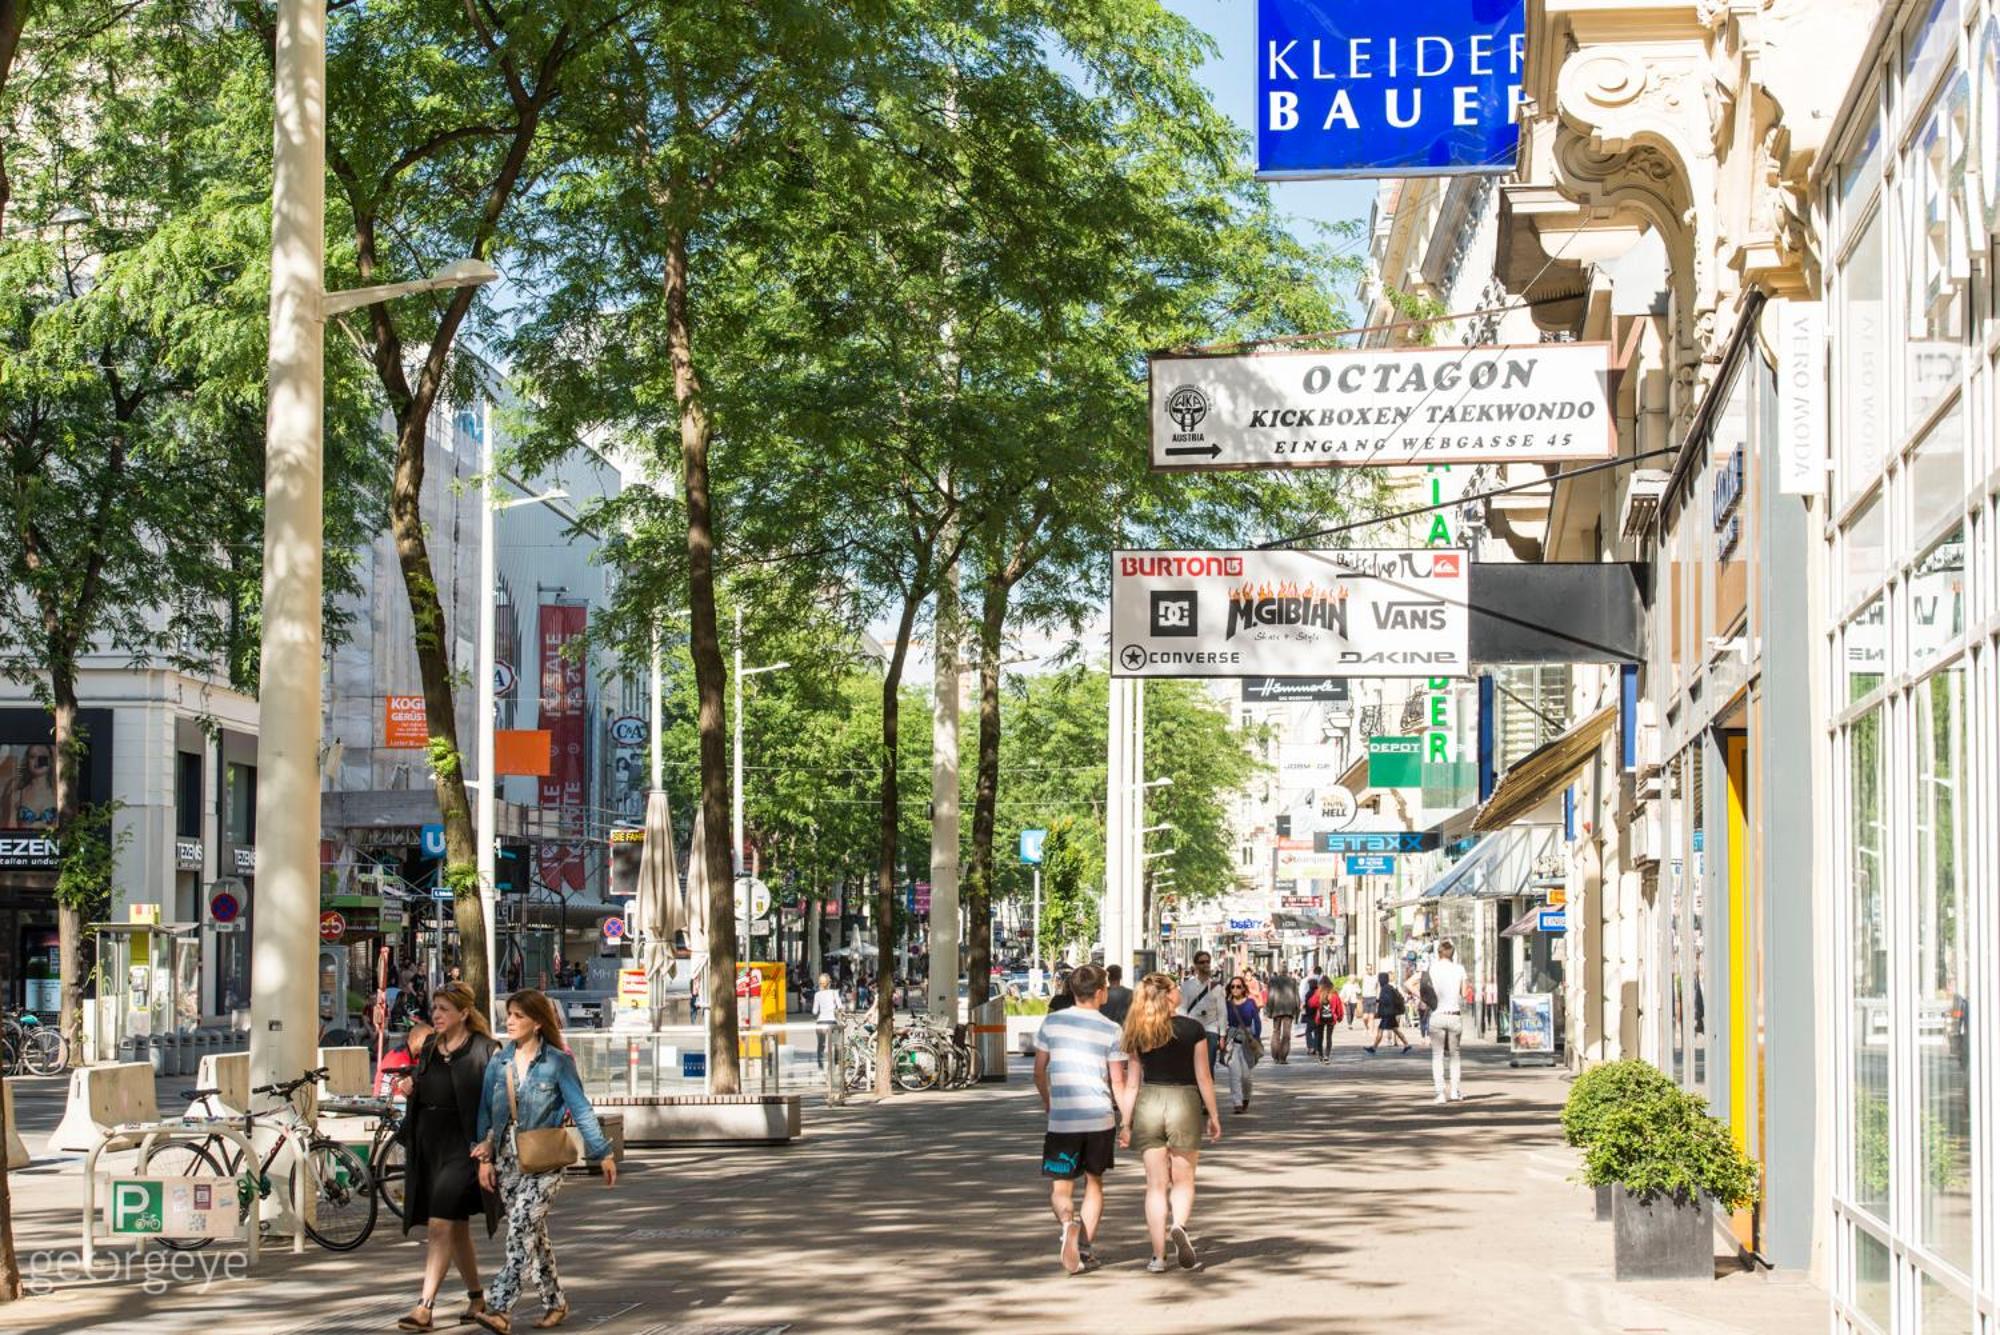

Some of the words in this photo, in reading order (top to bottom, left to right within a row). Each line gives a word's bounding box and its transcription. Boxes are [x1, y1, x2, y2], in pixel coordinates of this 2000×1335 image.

[1268, 33, 1525, 80] KLEIDER
[1792, 317, 1810, 388] VERO
[1302, 358, 1538, 395] OCTAGON
[1249, 406, 1413, 428] KICKBOXEN
[1426, 400, 1596, 424] TAEKWONDO
[1172, 433, 1205, 442] AUSTRIA
[1275, 438, 1386, 455] EINGANG
[1402, 434, 1535, 451] WEBGASSE
[1547, 433, 1572, 447] 45
[1793, 396, 1811, 478] MODA
[1121, 556, 1222, 577] BURTON
[1371, 601, 1447, 631] VANS
[1149, 652, 1240, 664] CONVERSE
[617, 724, 644, 739] C&A
[1370, 743, 1420, 753] DEPOT
[426, 831, 446, 853] U
[116, 1184, 150, 1230] P
